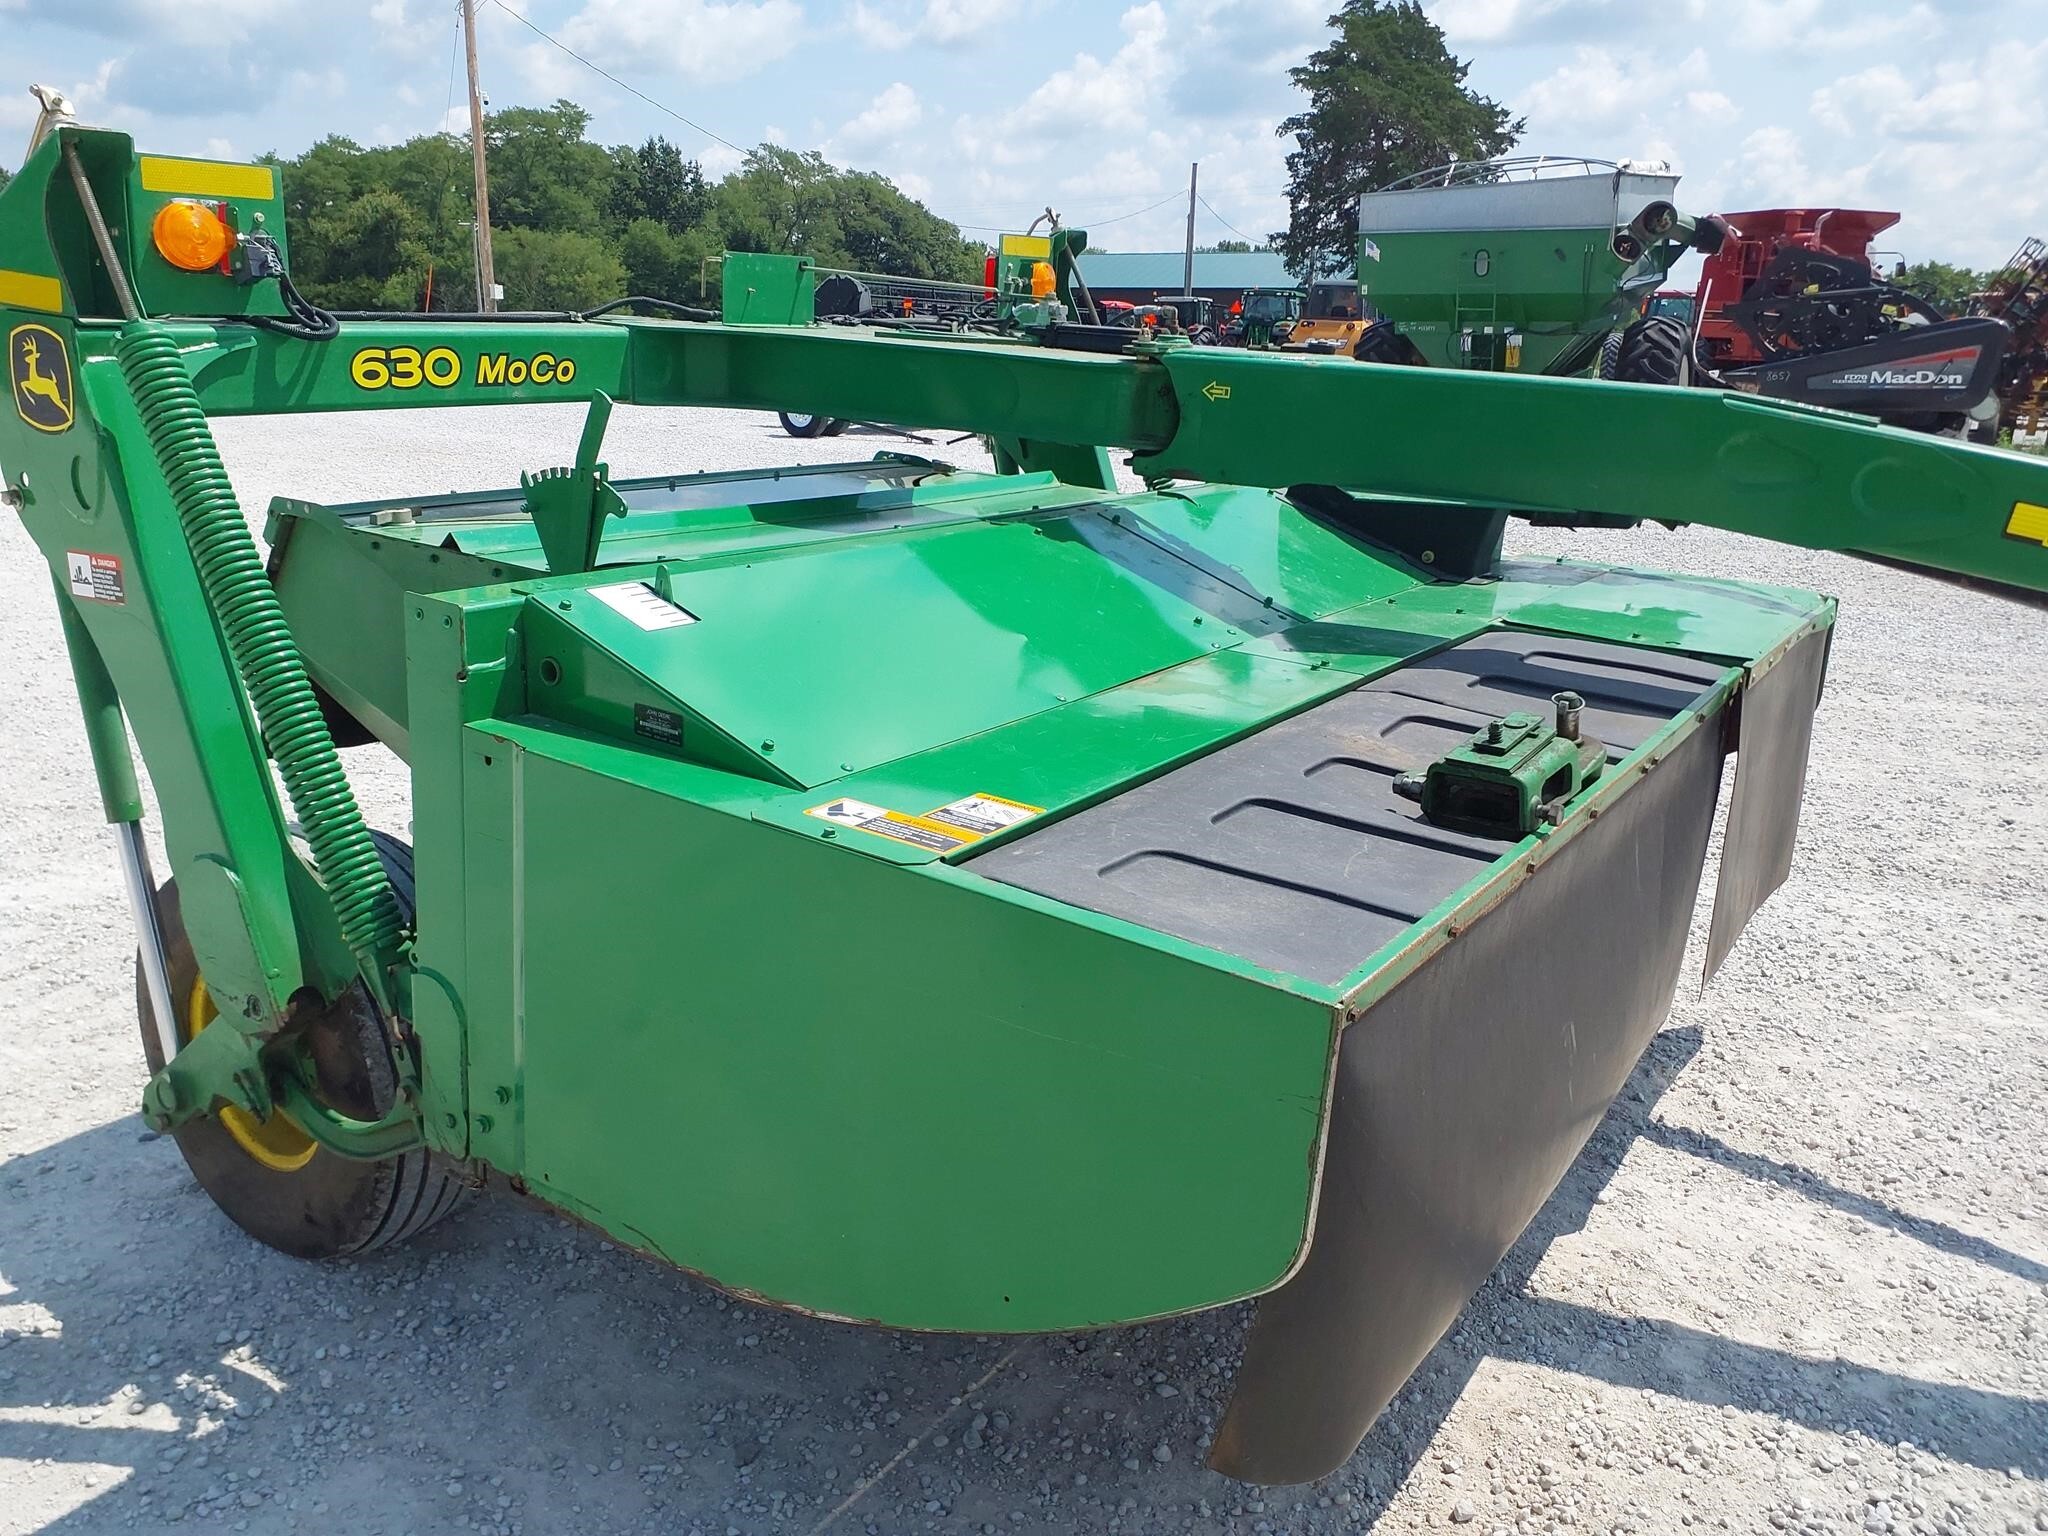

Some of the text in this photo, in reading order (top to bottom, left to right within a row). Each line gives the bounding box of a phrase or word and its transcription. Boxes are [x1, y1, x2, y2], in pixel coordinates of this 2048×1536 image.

[351, 347, 575, 389] 630 MoCo
[1869, 371, 1963, 384] MacDon
